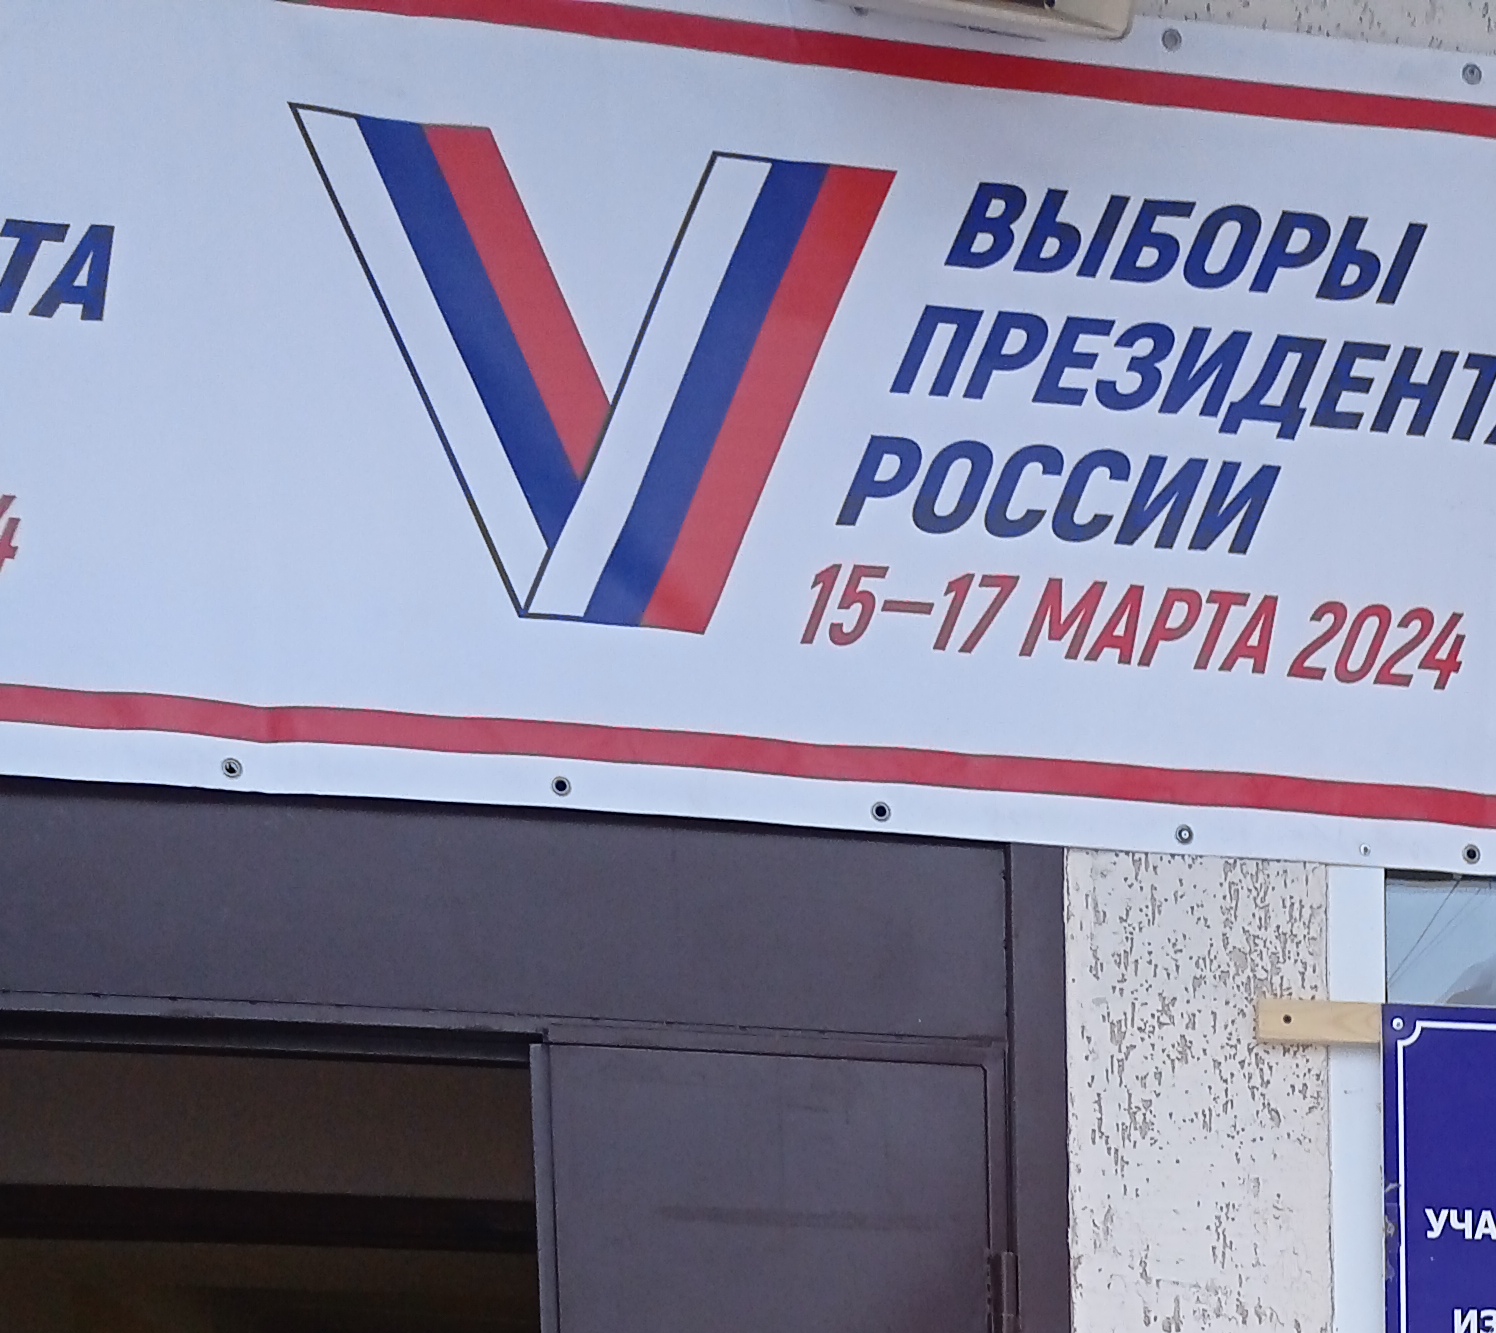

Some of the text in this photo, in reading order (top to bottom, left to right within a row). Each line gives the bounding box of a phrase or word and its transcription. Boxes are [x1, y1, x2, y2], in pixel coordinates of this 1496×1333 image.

[944, 181, 1427, 305] ВЫБОРЫ
[835, 434, 1281, 555] РОССИИ
[1018, 577, 1279, 677] МАРТА
[1287, 600, 1466, 691] 2024
